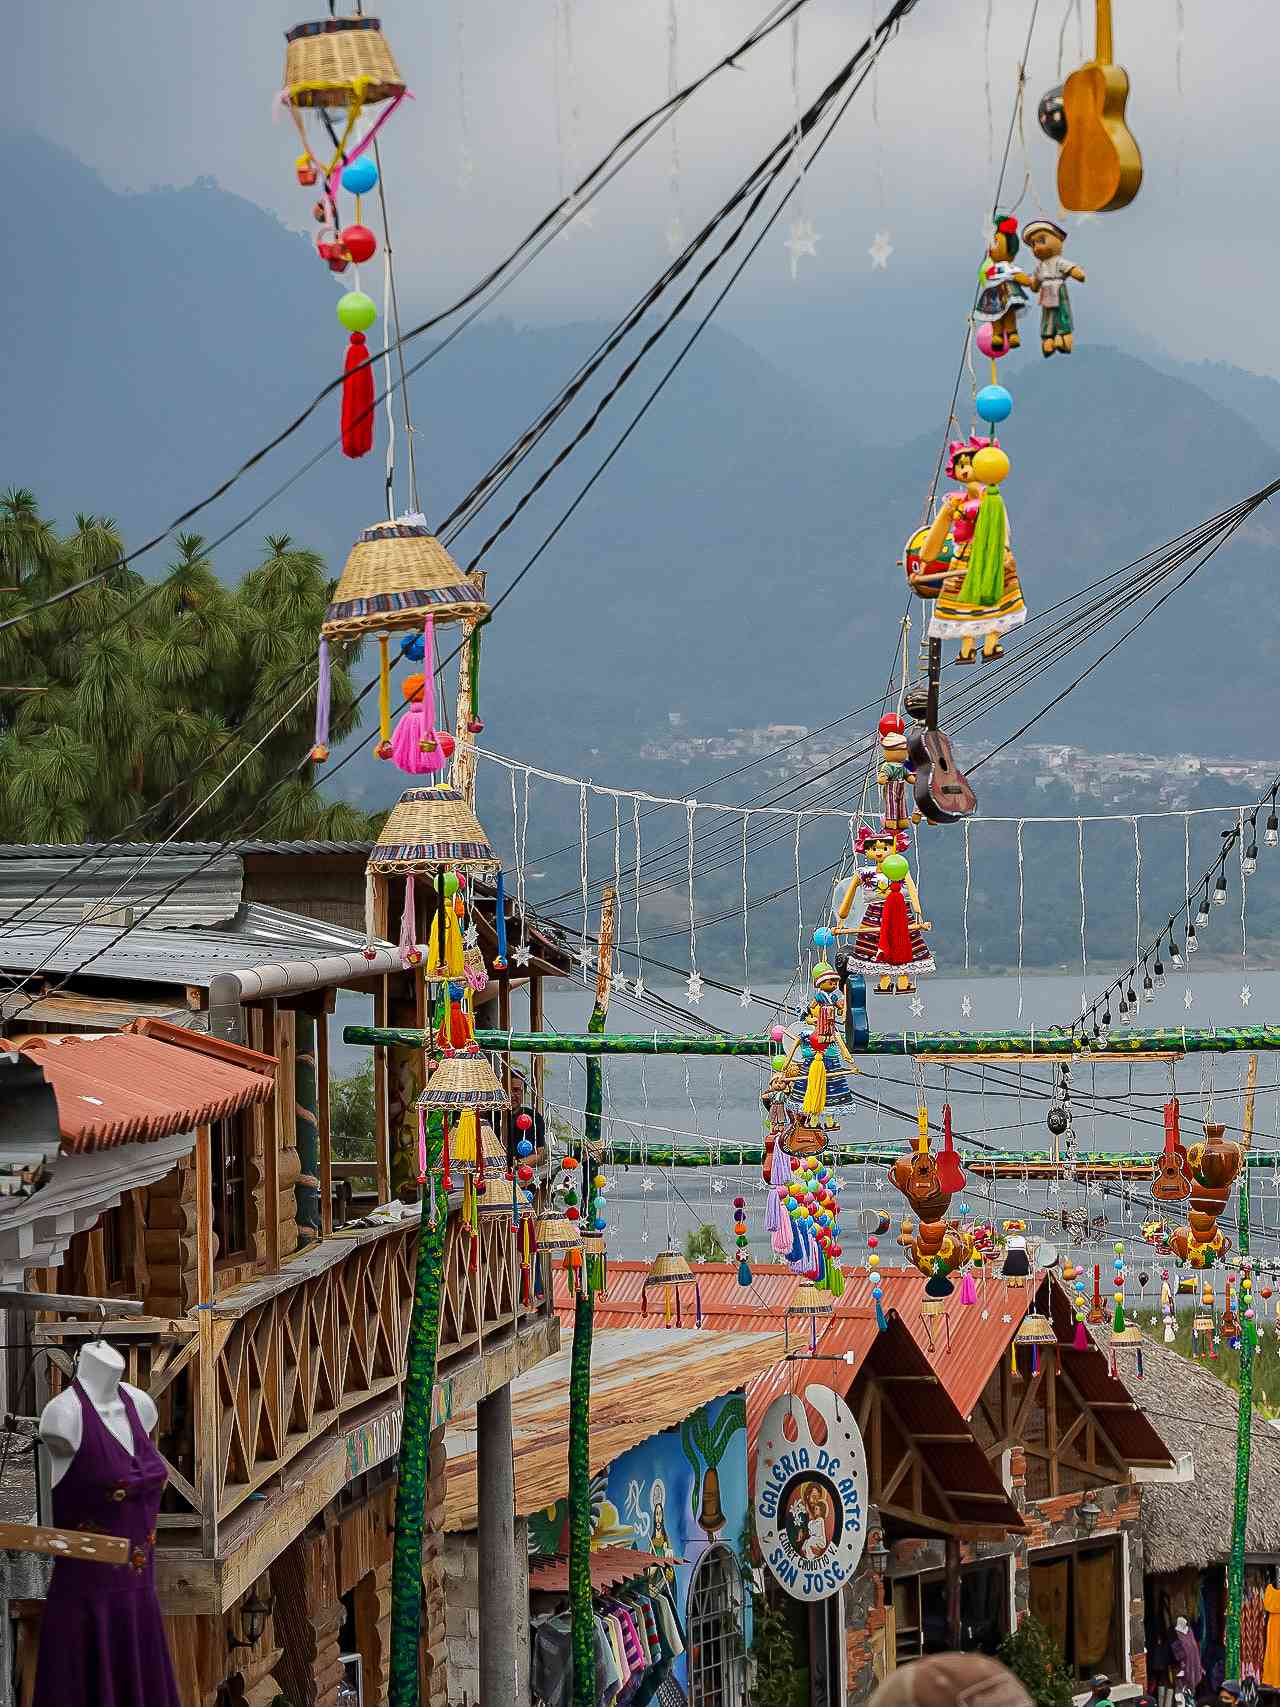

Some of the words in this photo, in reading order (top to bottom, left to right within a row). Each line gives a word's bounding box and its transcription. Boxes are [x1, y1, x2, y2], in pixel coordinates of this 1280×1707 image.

[759, 1447, 810, 1518] GALERIA
[815, 1449, 841, 1477] DE
[839, 1478, 861, 1532] ARTE
[770, 1548, 798, 1587] SAN
